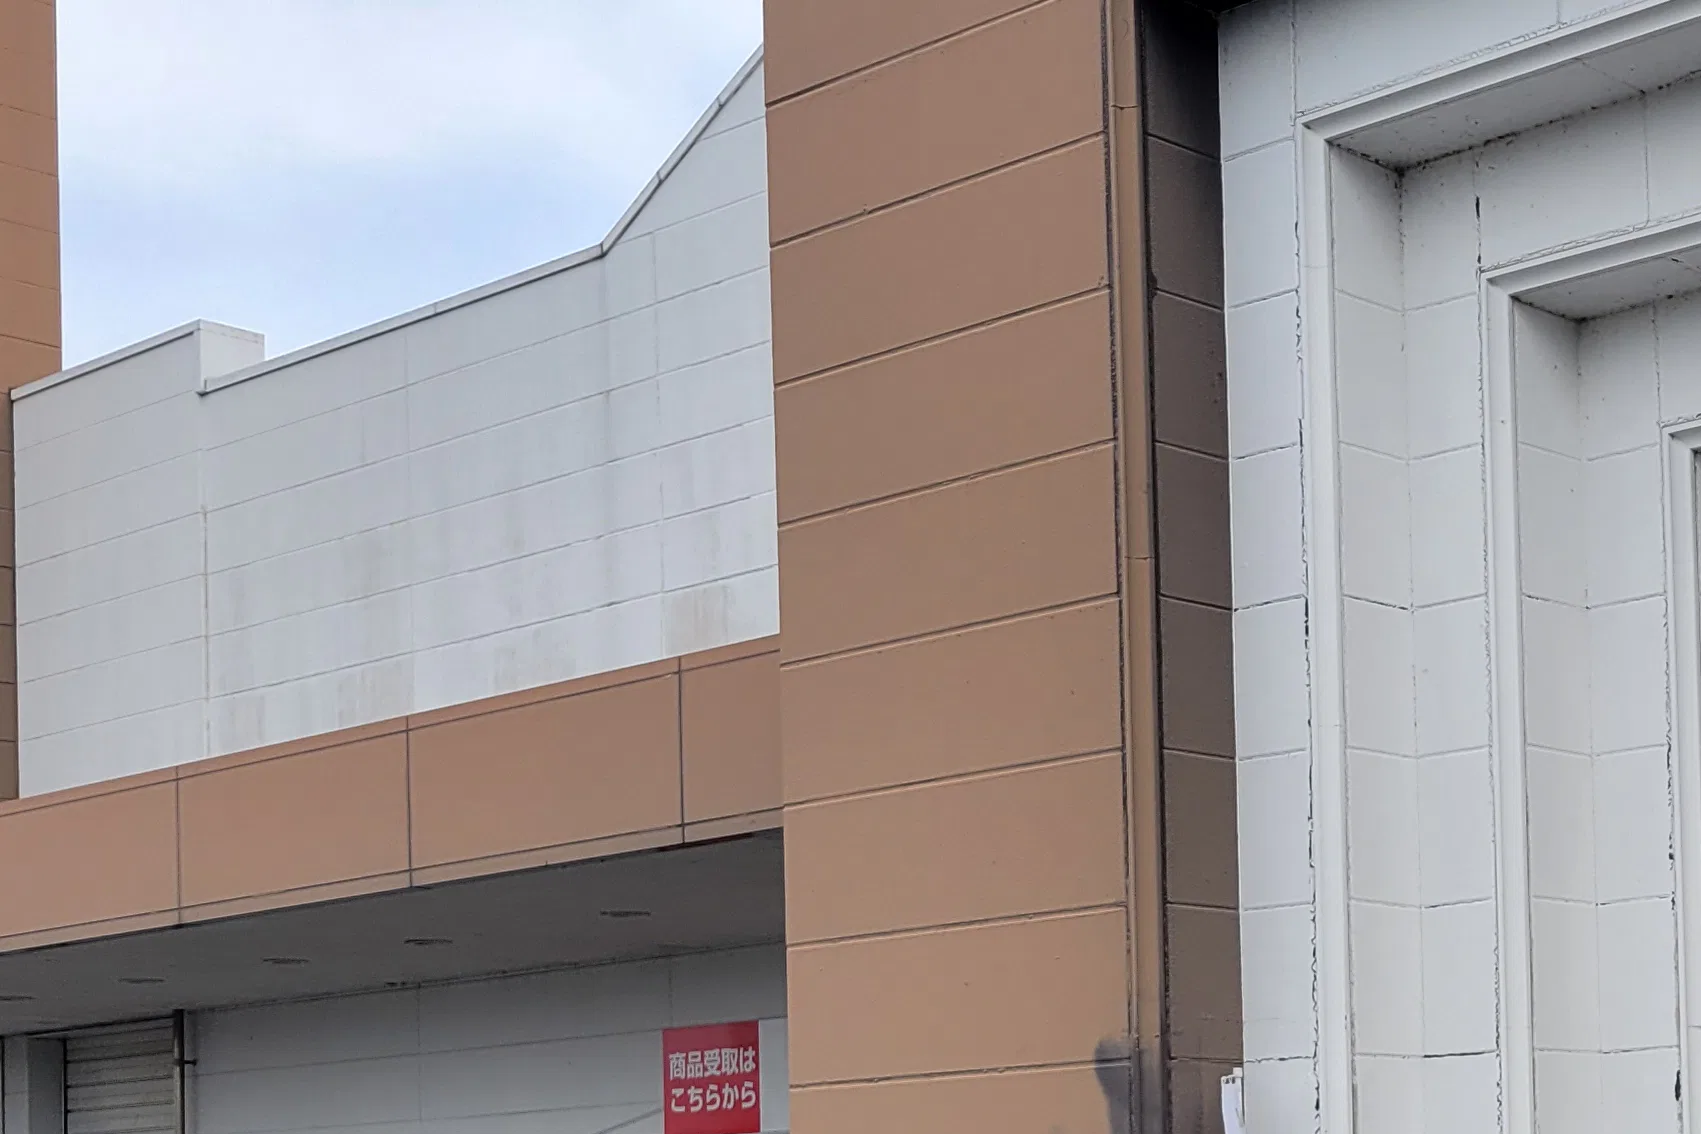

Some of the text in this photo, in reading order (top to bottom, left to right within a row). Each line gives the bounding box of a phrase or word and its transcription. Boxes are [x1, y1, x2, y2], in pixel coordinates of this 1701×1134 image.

[669, 1045, 756, 1080] 商品受取は
[671, 1081, 756, 1113] こちらから
